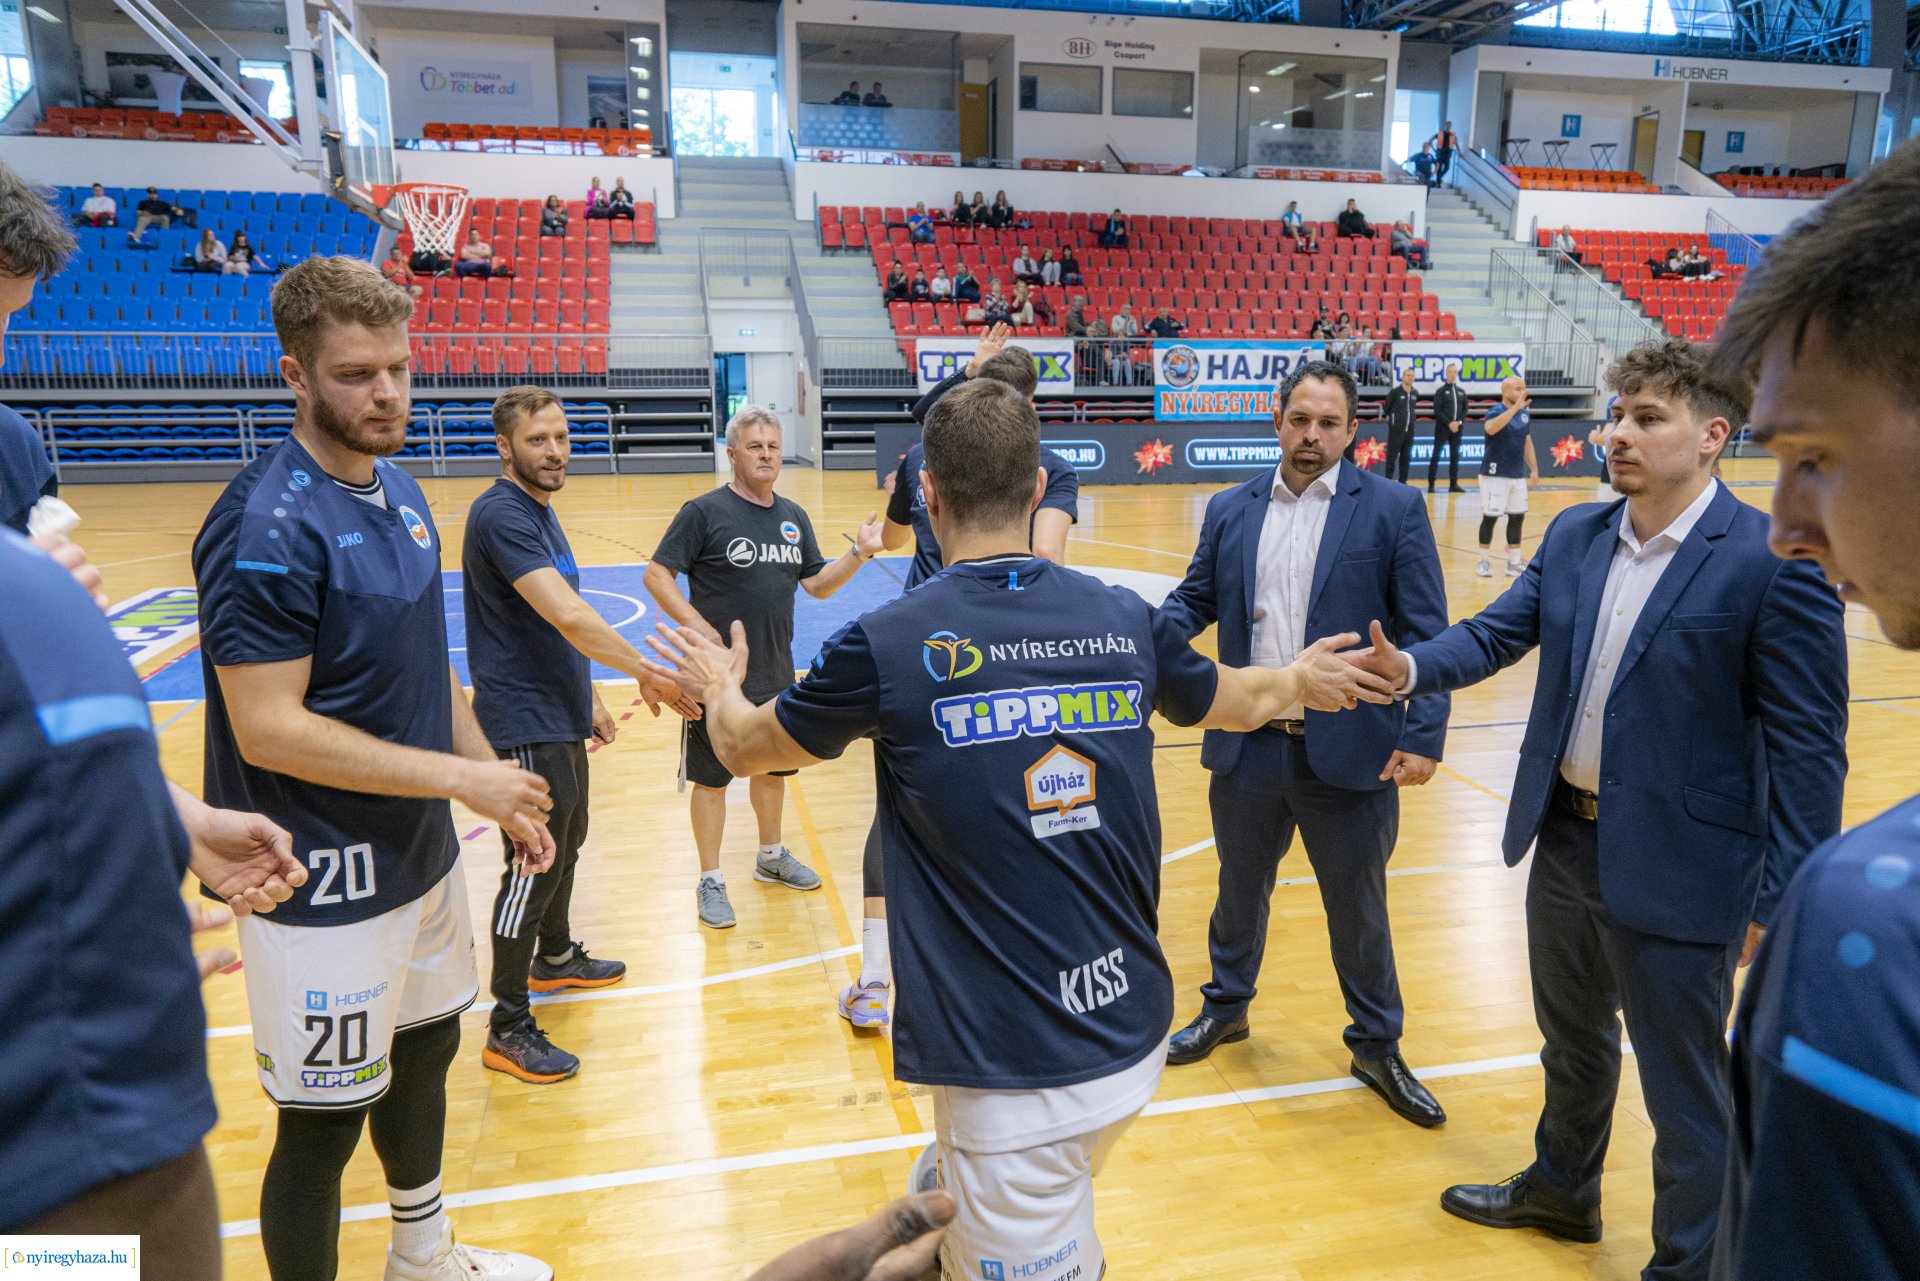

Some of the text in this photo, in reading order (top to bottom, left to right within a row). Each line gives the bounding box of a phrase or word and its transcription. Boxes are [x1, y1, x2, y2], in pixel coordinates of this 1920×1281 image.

[1069, 41, 1091, 55] BH
[1113, 51, 1145, 60] Csoport
[1125, 41, 1155, 51] Holding
[1161, 385, 1281, 414] NYÍREGYHÁ
[1194, 447, 1283, 461] WWW.TIPPMIXP
[1489, 462, 1497, 474] 3
[759, 543, 803, 565] JAKO
[989, 633, 1138, 662] NYÍREGYHÁZA
[1048, 816, 1088, 829] Farm-Ker
[309, 843, 376, 906] 20
[1059, 947, 1129, 1015] KISS
[335, 981, 388, 1007] HÜBNER
[303, 1010, 368, 1067] 20
[1012, 1239, 1078, 1278] HÜBNER
